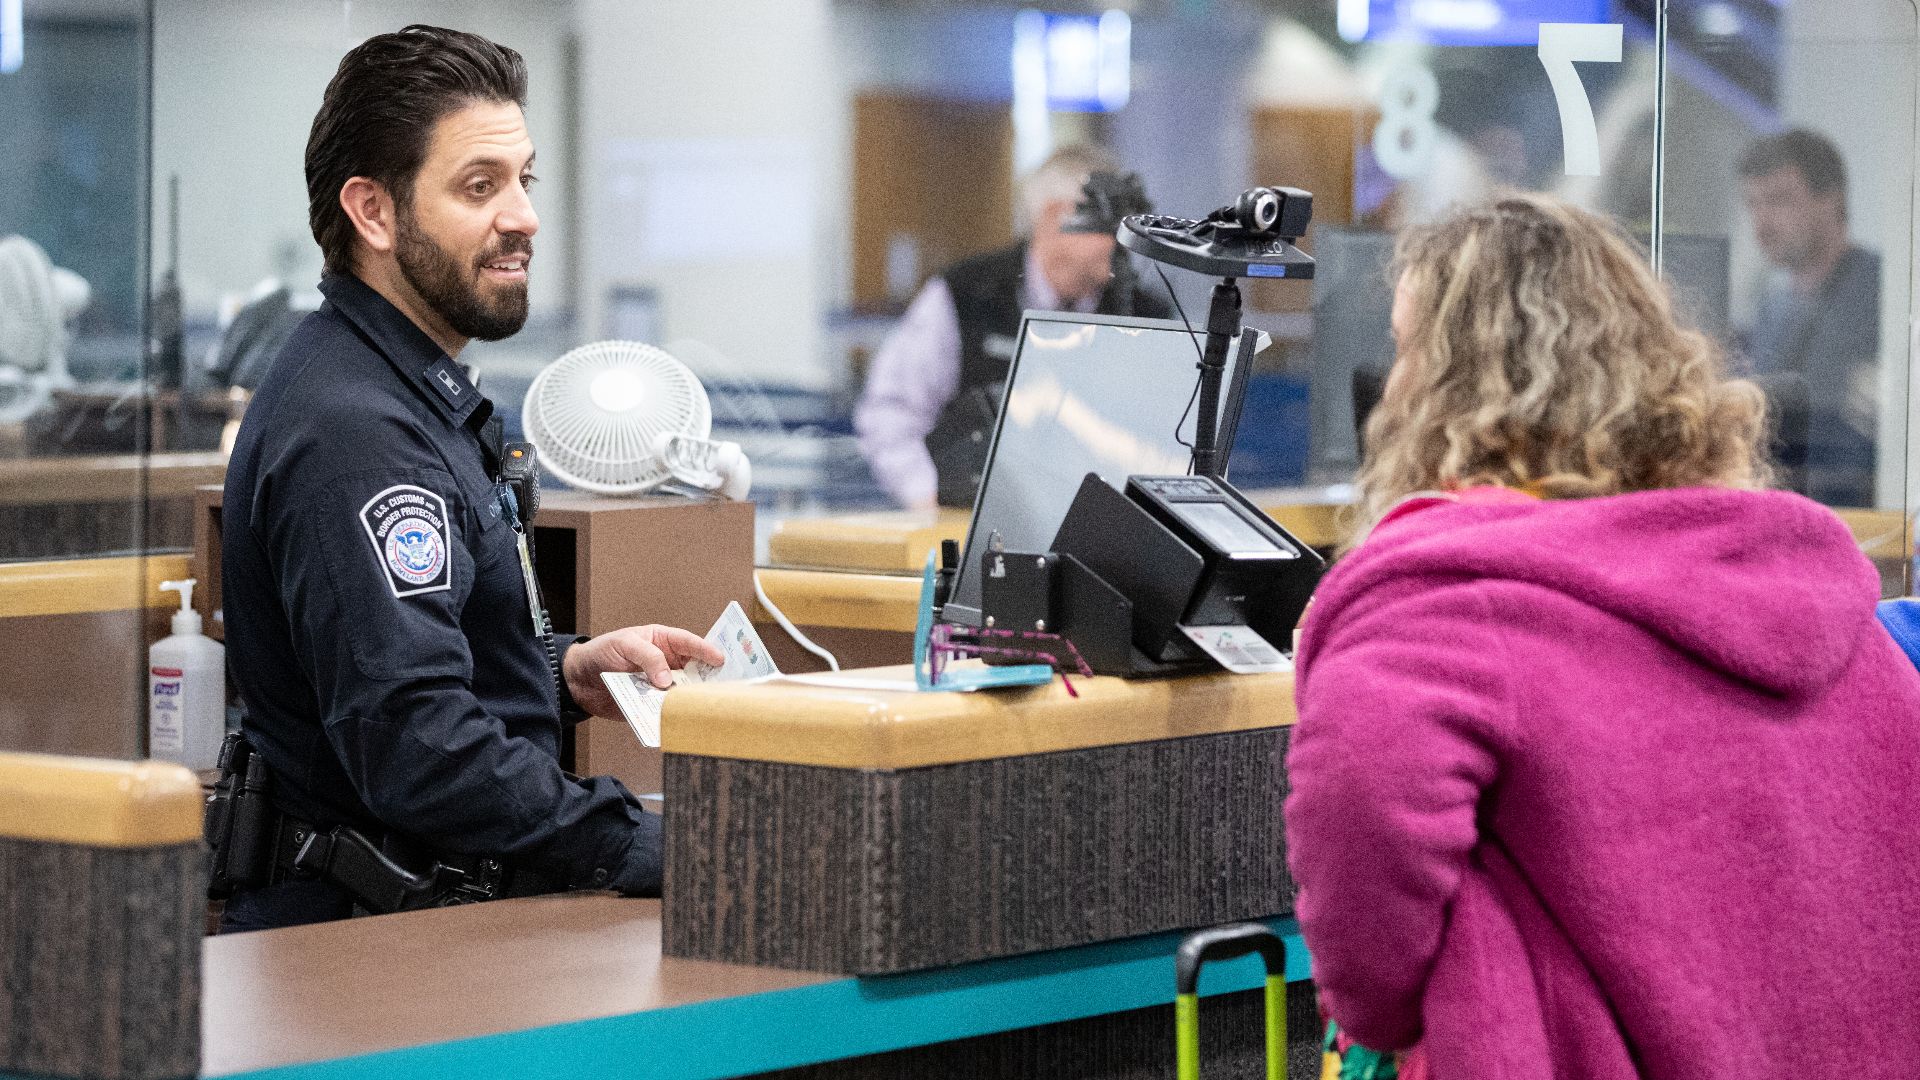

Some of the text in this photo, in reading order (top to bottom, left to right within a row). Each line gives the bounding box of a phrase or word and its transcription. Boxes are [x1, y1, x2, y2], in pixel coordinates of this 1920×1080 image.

[373, 504, 389, 518] U.S.
[388, 494, 425, 507] CUSTOMS
[377, 506, 443, 538] BORDER PROTECTION
